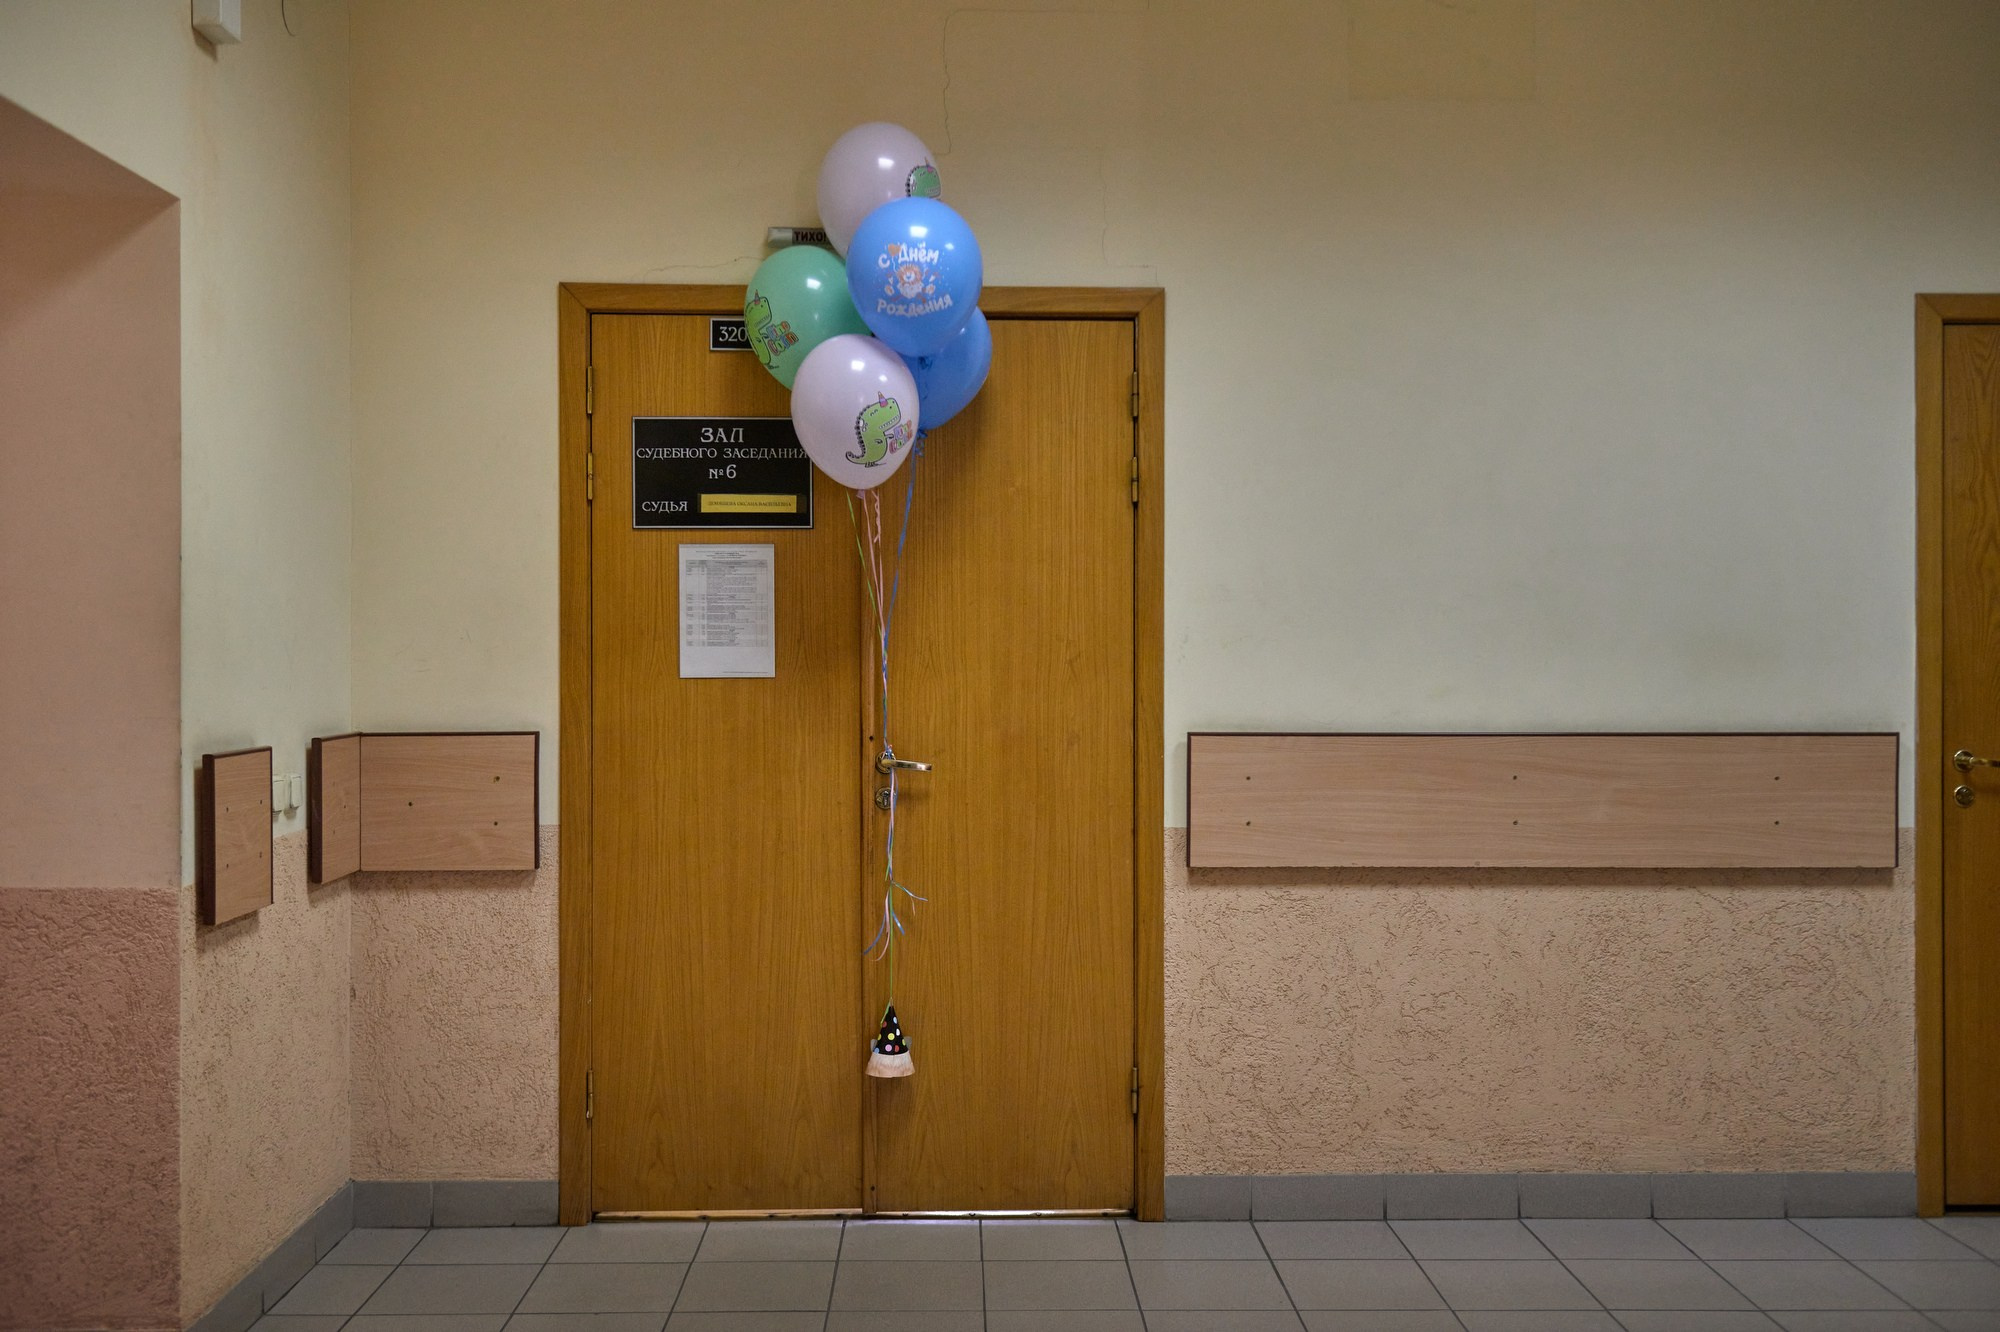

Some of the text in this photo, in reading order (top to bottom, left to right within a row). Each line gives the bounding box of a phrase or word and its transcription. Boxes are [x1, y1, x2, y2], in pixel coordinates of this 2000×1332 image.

[898, 241, 939, 265] Днём
[877, 293, 953, 317] Рождения
[719, 326, 747, 342] 320
[700, 427, 744, 443] ЗАЛ
[636, 447, 807, 460] СУДЕБНОГО ЗАСЕДАНИЯ
[641, 501, 688, 514] СУДЬЯ
